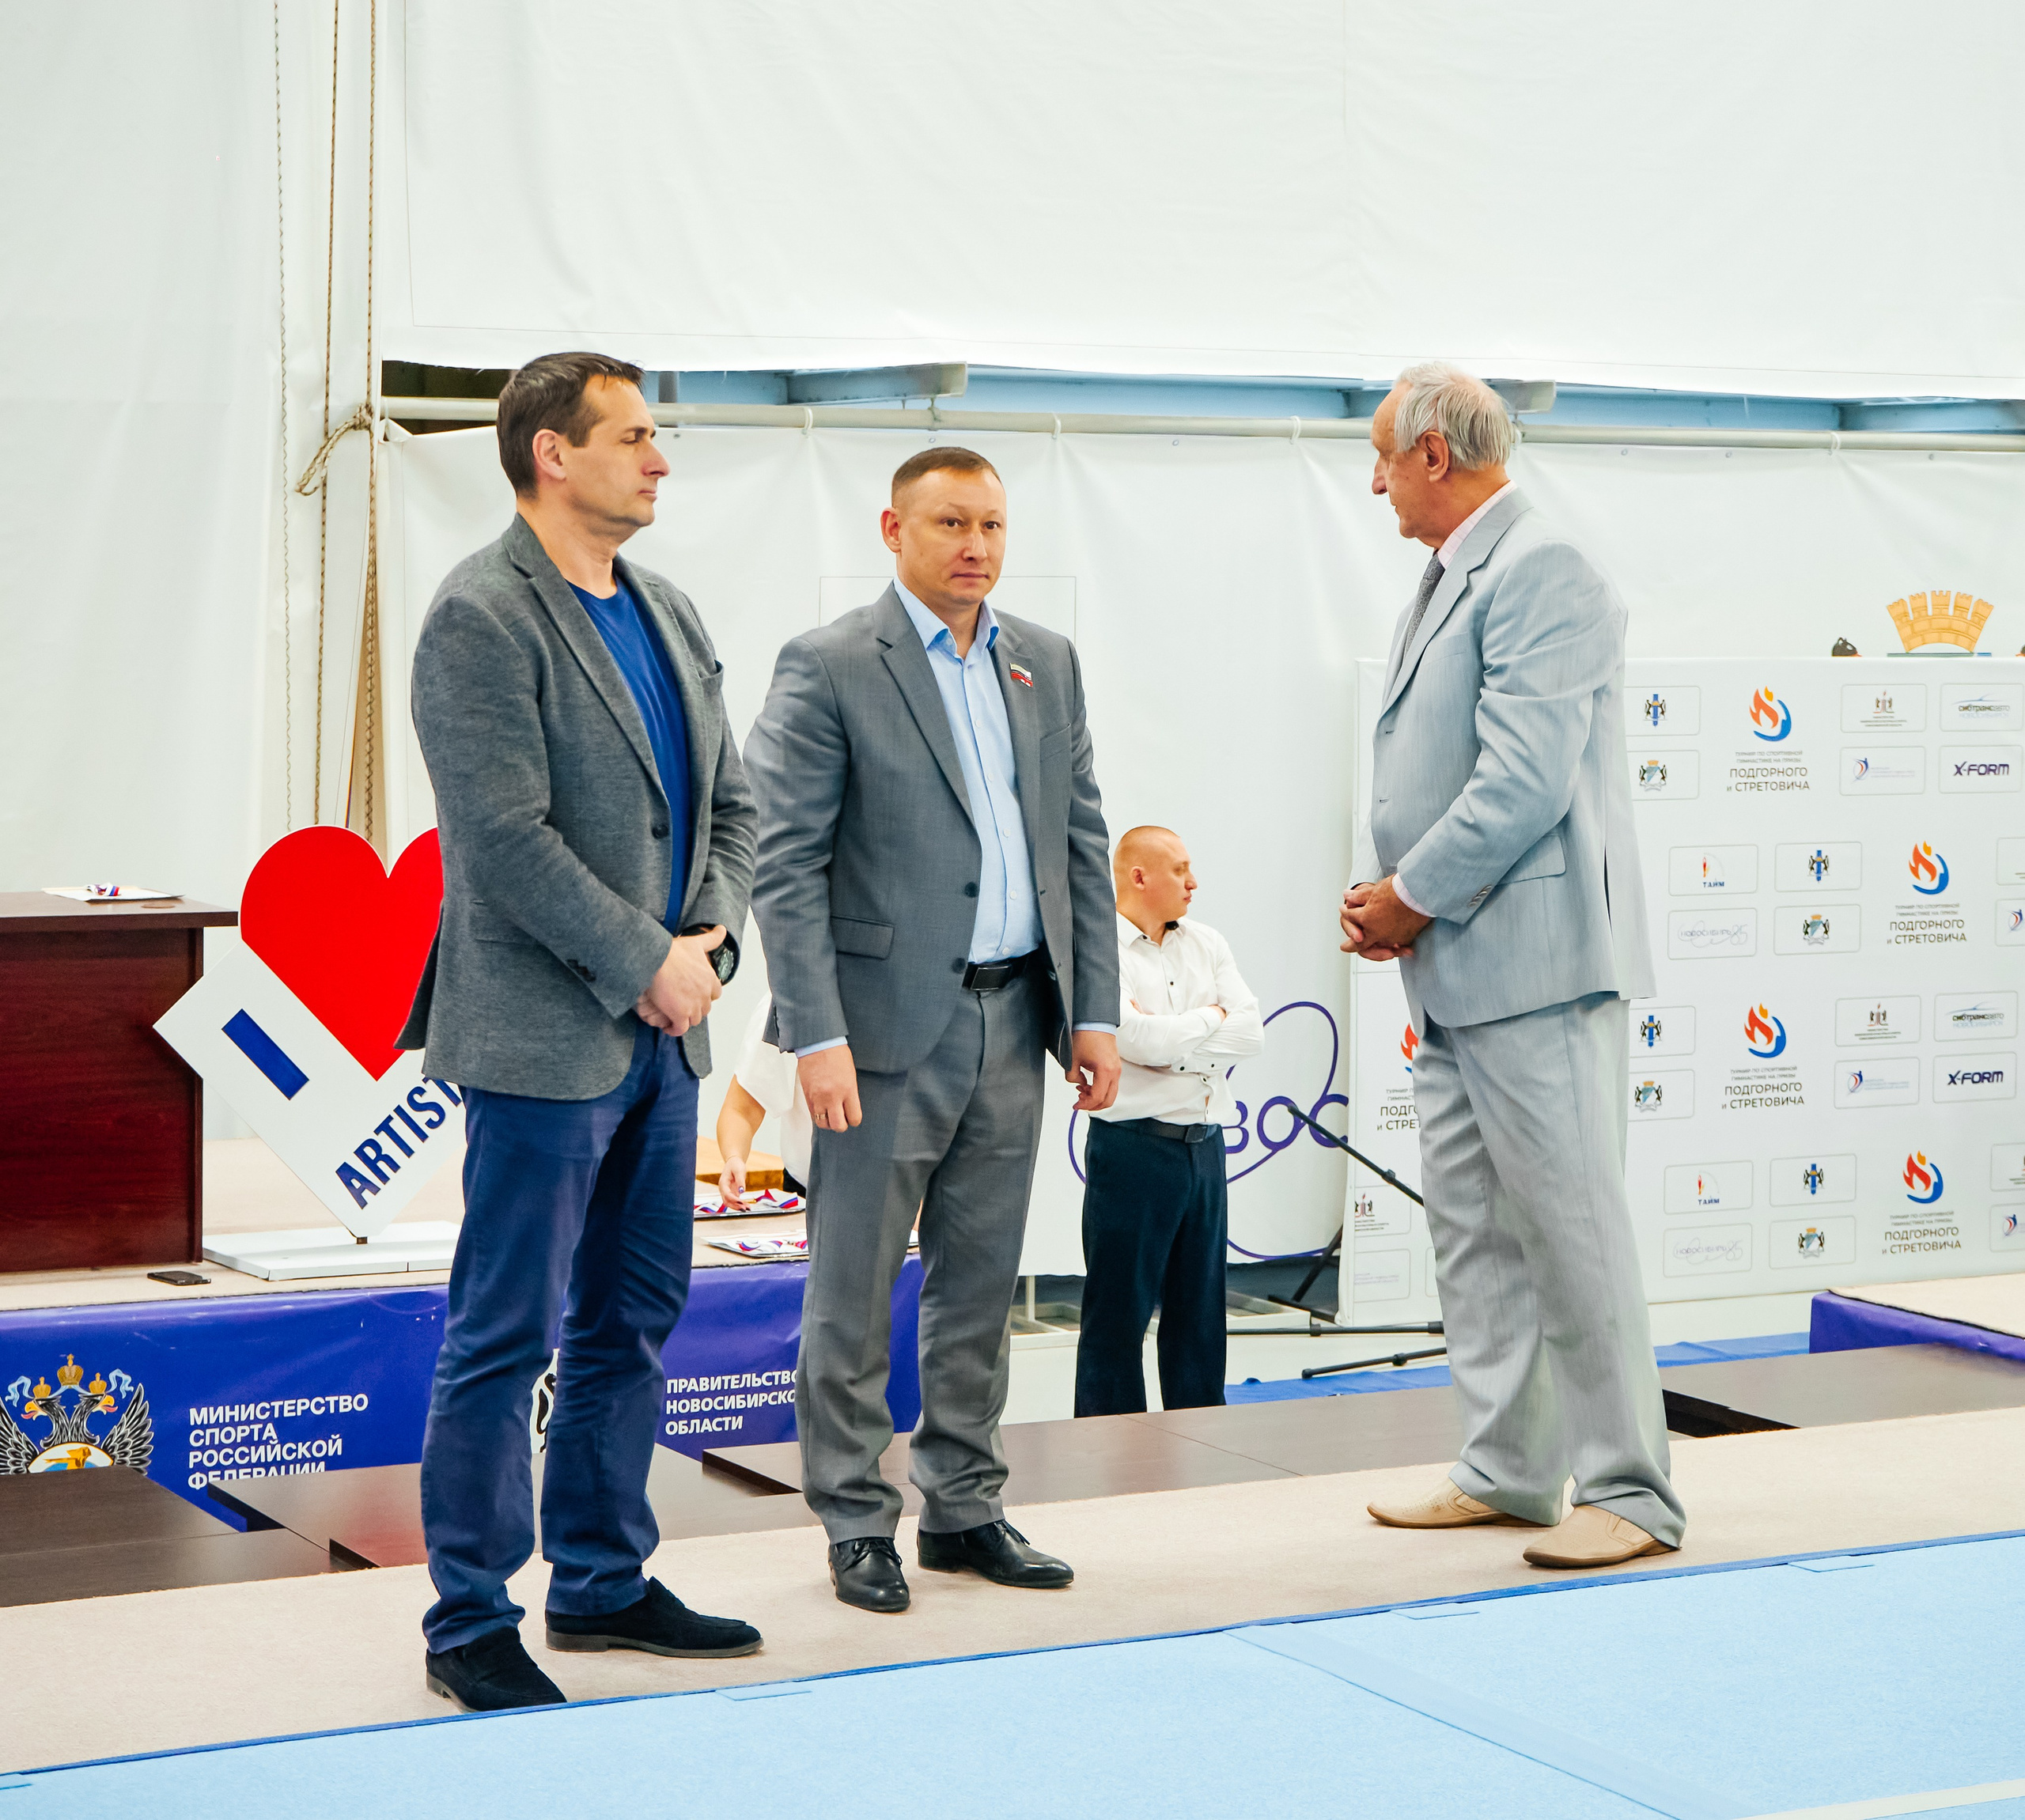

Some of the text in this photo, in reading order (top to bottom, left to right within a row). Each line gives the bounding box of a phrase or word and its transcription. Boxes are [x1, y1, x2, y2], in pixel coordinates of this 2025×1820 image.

[1730, 767, 1807, 778] ПОДГОРНОГО
[1953, 761, 2009, 776] X-FORM
[1735, 781, 1810, 792] СТРЕТОВИЧА
[1890, 919, 1964, 931] ПОДГОРНОГО
[1894, 933, 1966, 944] СТРЕТОВИЧА
[1947, 1070, 2004, 1085] X-FORM
[1724, 1082, 1802, 1095] ПОДГОРНОГО
[1730, 1095, 1804, 1109] СТРЕТОВИЧА
[335, 1077, 462, 1209] ARTIST
[1885, 1227, 1959, 1240] ПОДГОРНОГО
[1890, 1240, 1961, 1254] СТРЕТОВИЧА
[189, 1394, 369, 1426] МИНИСТЕРСТВО
[665, 1415, 744, 1436] ОБЛАСТИ
[189, 1423, 278, 1447] СПОРТА
[188, 1434, 343, 1469] РОССИЙСКОЙ
